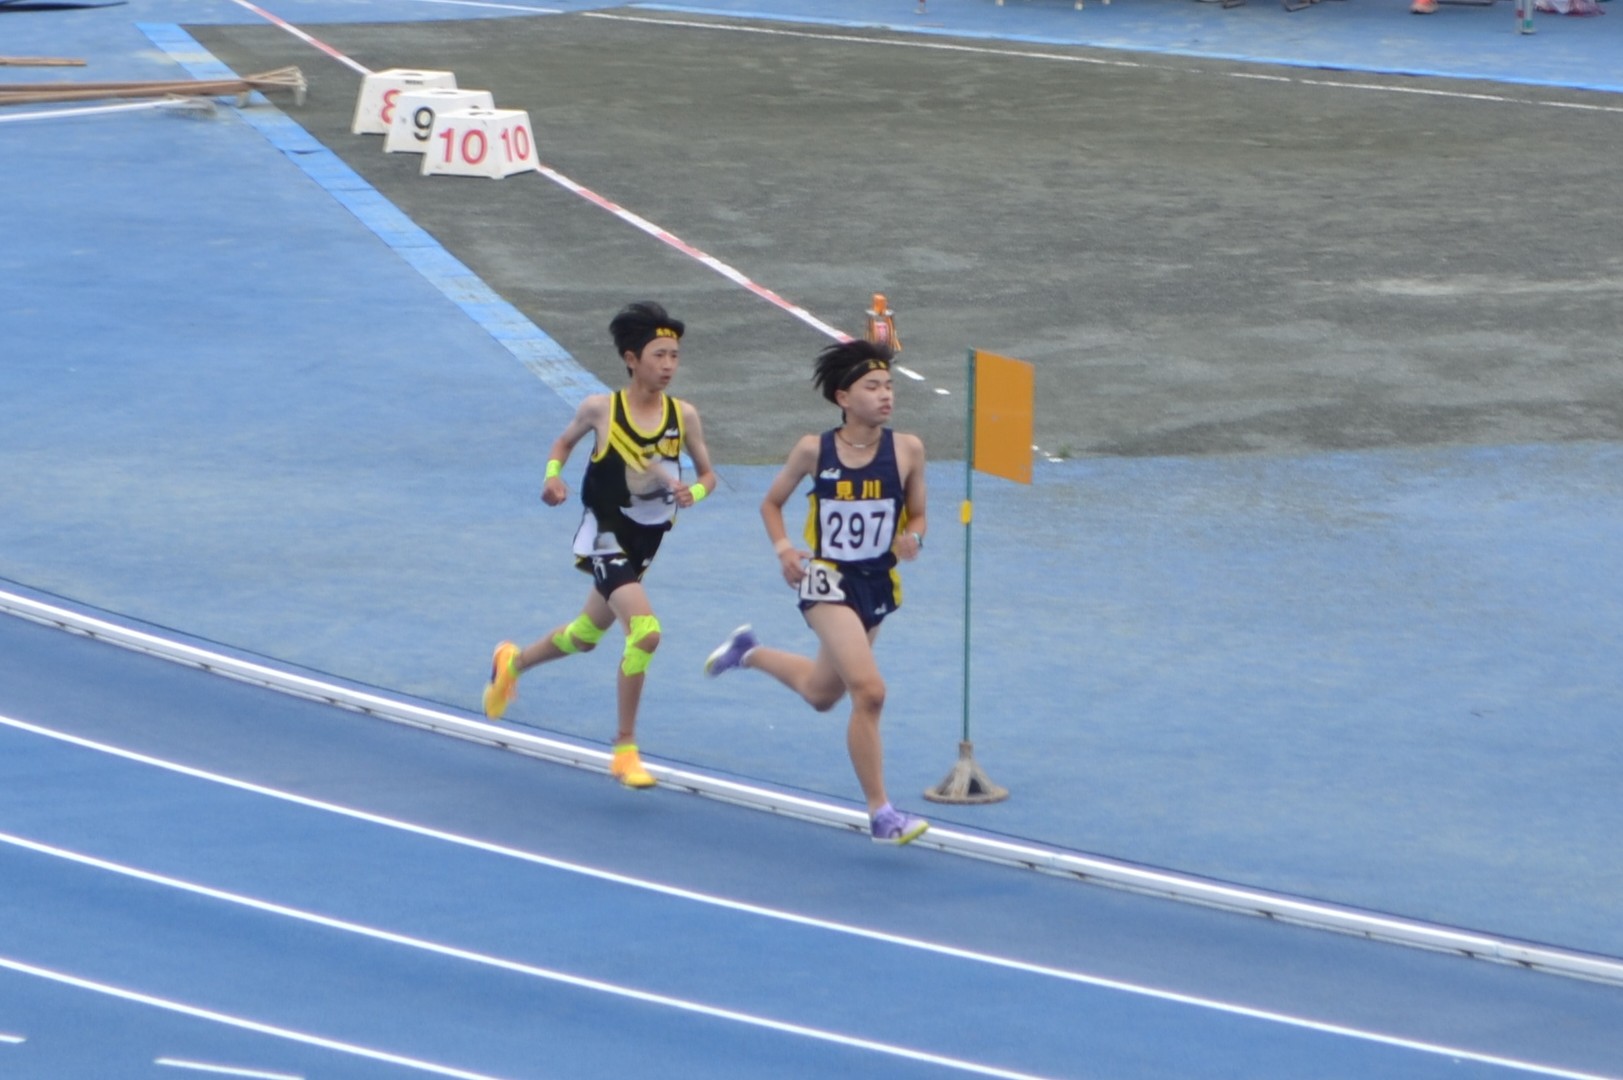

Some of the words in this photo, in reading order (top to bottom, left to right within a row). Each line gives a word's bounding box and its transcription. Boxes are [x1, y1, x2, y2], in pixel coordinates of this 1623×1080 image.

[414, 106, 435, 141] 9
[439, 128, 488, 165] 10
[501, 125, 530, 162] 10
[827, 511, 886, 549] 297
[807, 569, 831, 596] 13
